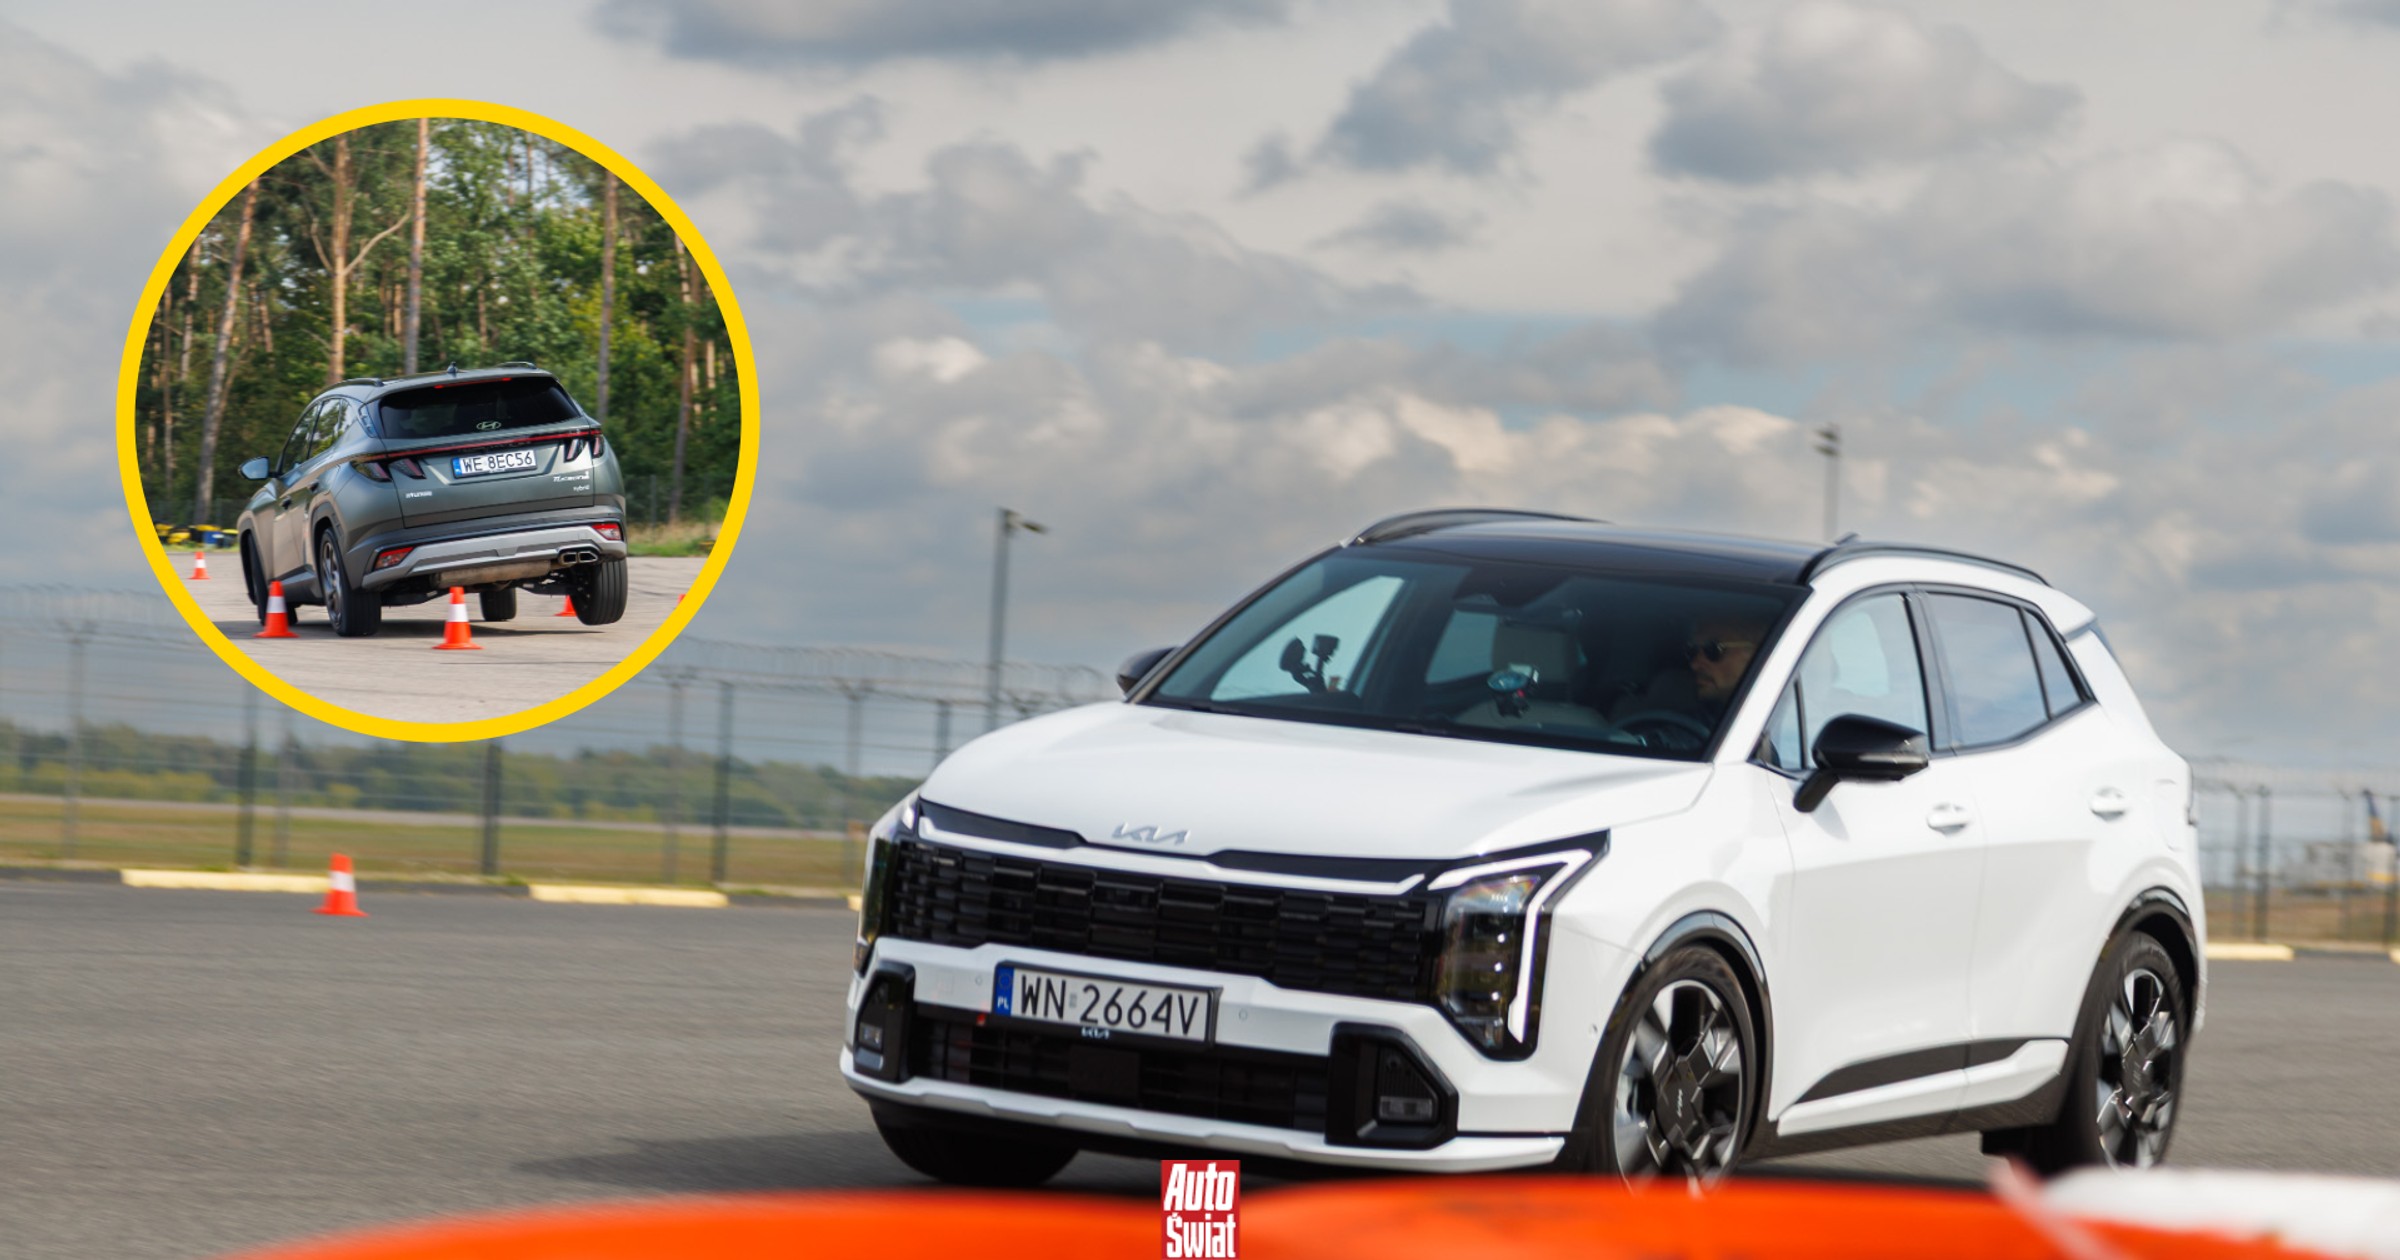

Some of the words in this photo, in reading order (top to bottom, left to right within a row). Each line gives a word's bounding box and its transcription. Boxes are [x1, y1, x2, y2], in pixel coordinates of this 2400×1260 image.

[462, 457, 483, 473] WE
[487, 451, 533, 469] 8EC56
[997, 996, 1010, 1010] PL
[1020, 974, 1067, 1020] WN
[1079, 983, 1199, 1036] 2664V
